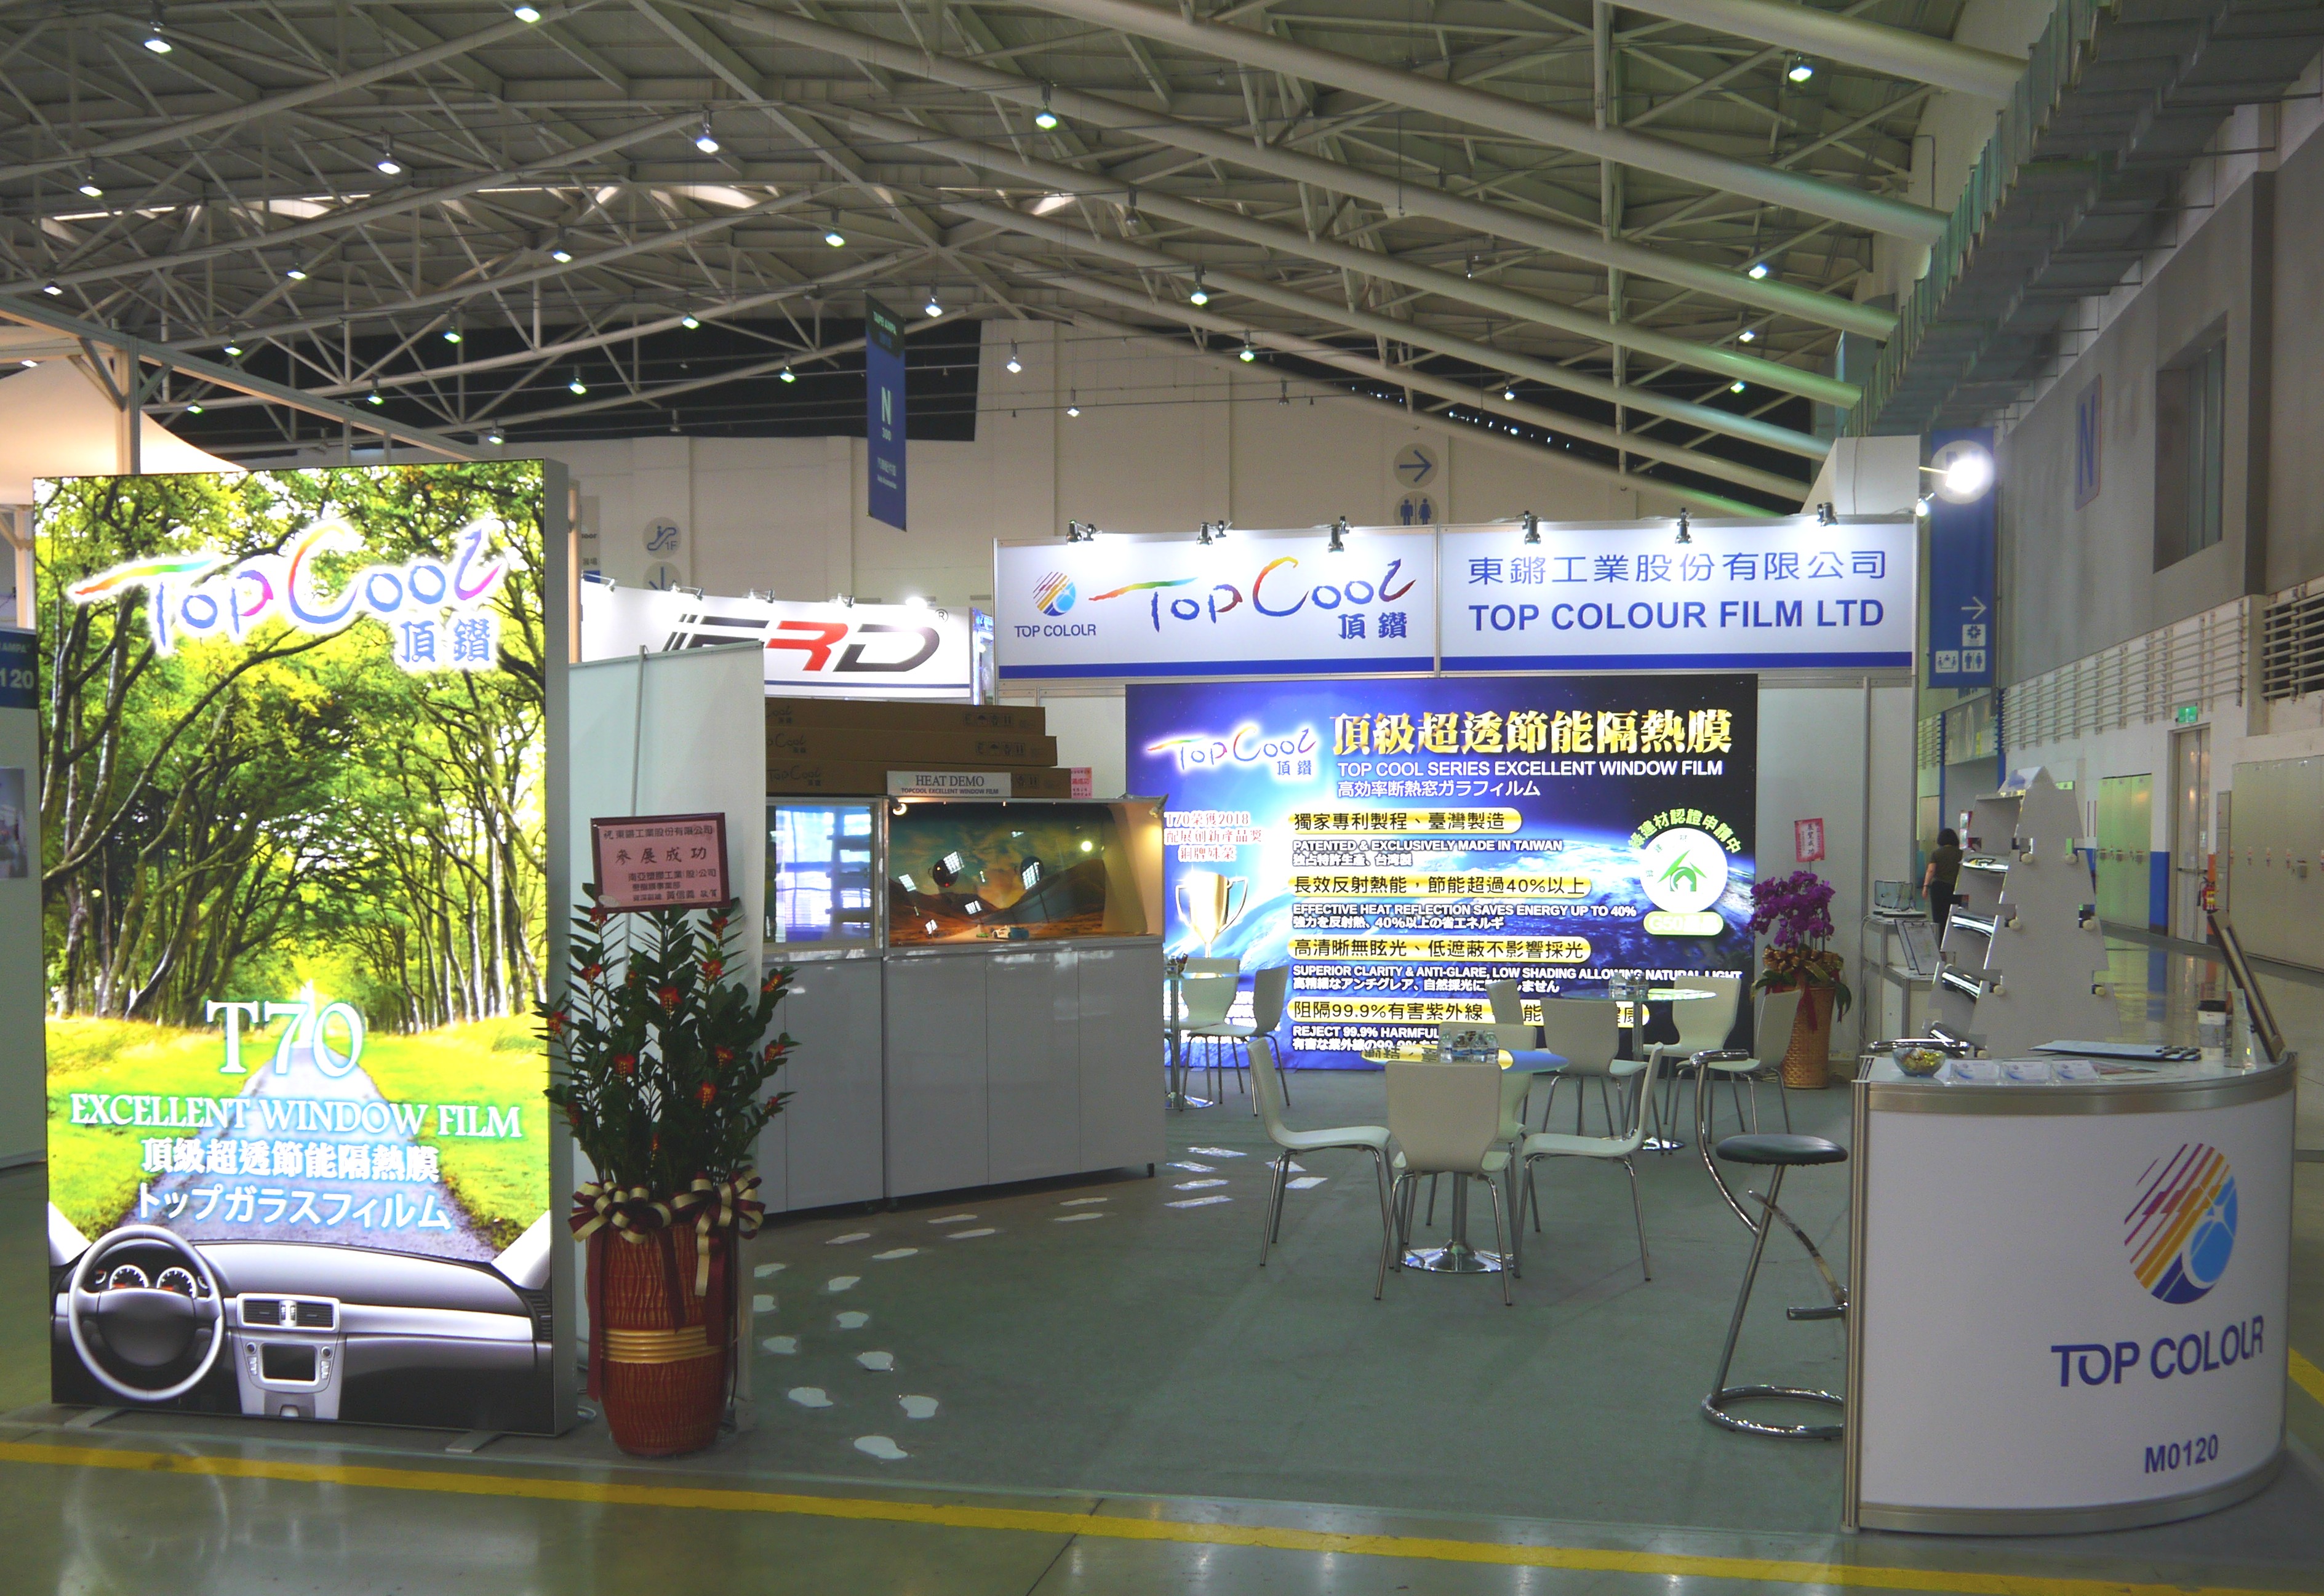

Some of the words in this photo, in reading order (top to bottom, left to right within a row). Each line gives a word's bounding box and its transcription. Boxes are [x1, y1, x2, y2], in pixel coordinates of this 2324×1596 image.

[881, 386, 892, 425] N
[665, 541, 677, 551] 1F
[1467, 551, 1887, 585] 東鏘工業股份有限公司
[1014, 625, 1040, 637] TOP
[1469, 604, 1539, 631] TOP
[1552, 601, 1707, 630] COLOUR
[1720, 600, 1802, 628] FILM
[1816, 599, 1884, 627] LTD
[1330, 709, 1733, 756] 頂級超透節能隔熱膜
[916, 775, 946, 786] HEAT
[949, 776, 984, 787] DEMO
[1338, 762, 1372, 777] TOP
[1376, 762, 1424, 777] COOL
[1427, 761, 1490, 776] SERIES
[1495, 760, 1595, 776] EXCELLENT
[1599, 760, 1677, 776] WINDOW
[1681, 760, 1723, 775] FILM
[1293, 840, 1357, 852] PATENTED
[1359, 840, 1370, 851] &
[1371, 840, 1455, 851] EXCLUSIVELY
[1458, 840, 1495, 851] MADE
[1498, 840, 1511, 850] IN
[1513, 840, 1563, 851] TAIWAN
[1293, 904, 1357, 915] EFFECTIVE
[1360, 904, 1392, 915] HEAT
[1394, 904, 1470, 916] REFLECTION
[1473, 904, 1514, 916] SAVES
[1516, 905, 1568, 916] ENERGY
[1570, 906, 1589, 916] UP
[1590, 906, 1608, 916] TO
[1611, 906, 1637, 917] 40%
[1293, 965, 1351, 976] SUPERIOR
[1353, 966, 1403, 976] CLARITY
[1405, 967, 1414, 976] &
[1416, 967, 1490, 979] ANTI-GLARE,
[1492, 967, 1520, 978] LOW
[1522, 968, 1576, 979] SHADING
[207, 1000, 364, 1077] T70
[1293, 1026, 1341, 1037] REJECT
[1343, 1026, 1378, 1038] 99.9%
[1381, 1027, 1439, 1039] HARMFUL
[70, 1093, 250, 1130] EXCELLENT
[258, 1098, 429, 1135] WINDOW
[437, 1104, 522, 1138] FILM
[142, 1137, 440, 1184] 頂級超透節能隔熱膜
[138, 1182, 453, 1231] トップガラスフィルム
[2051, 1341, 2141, 1387] TOP
[2144, 1434, 2219, 1474] M0120
